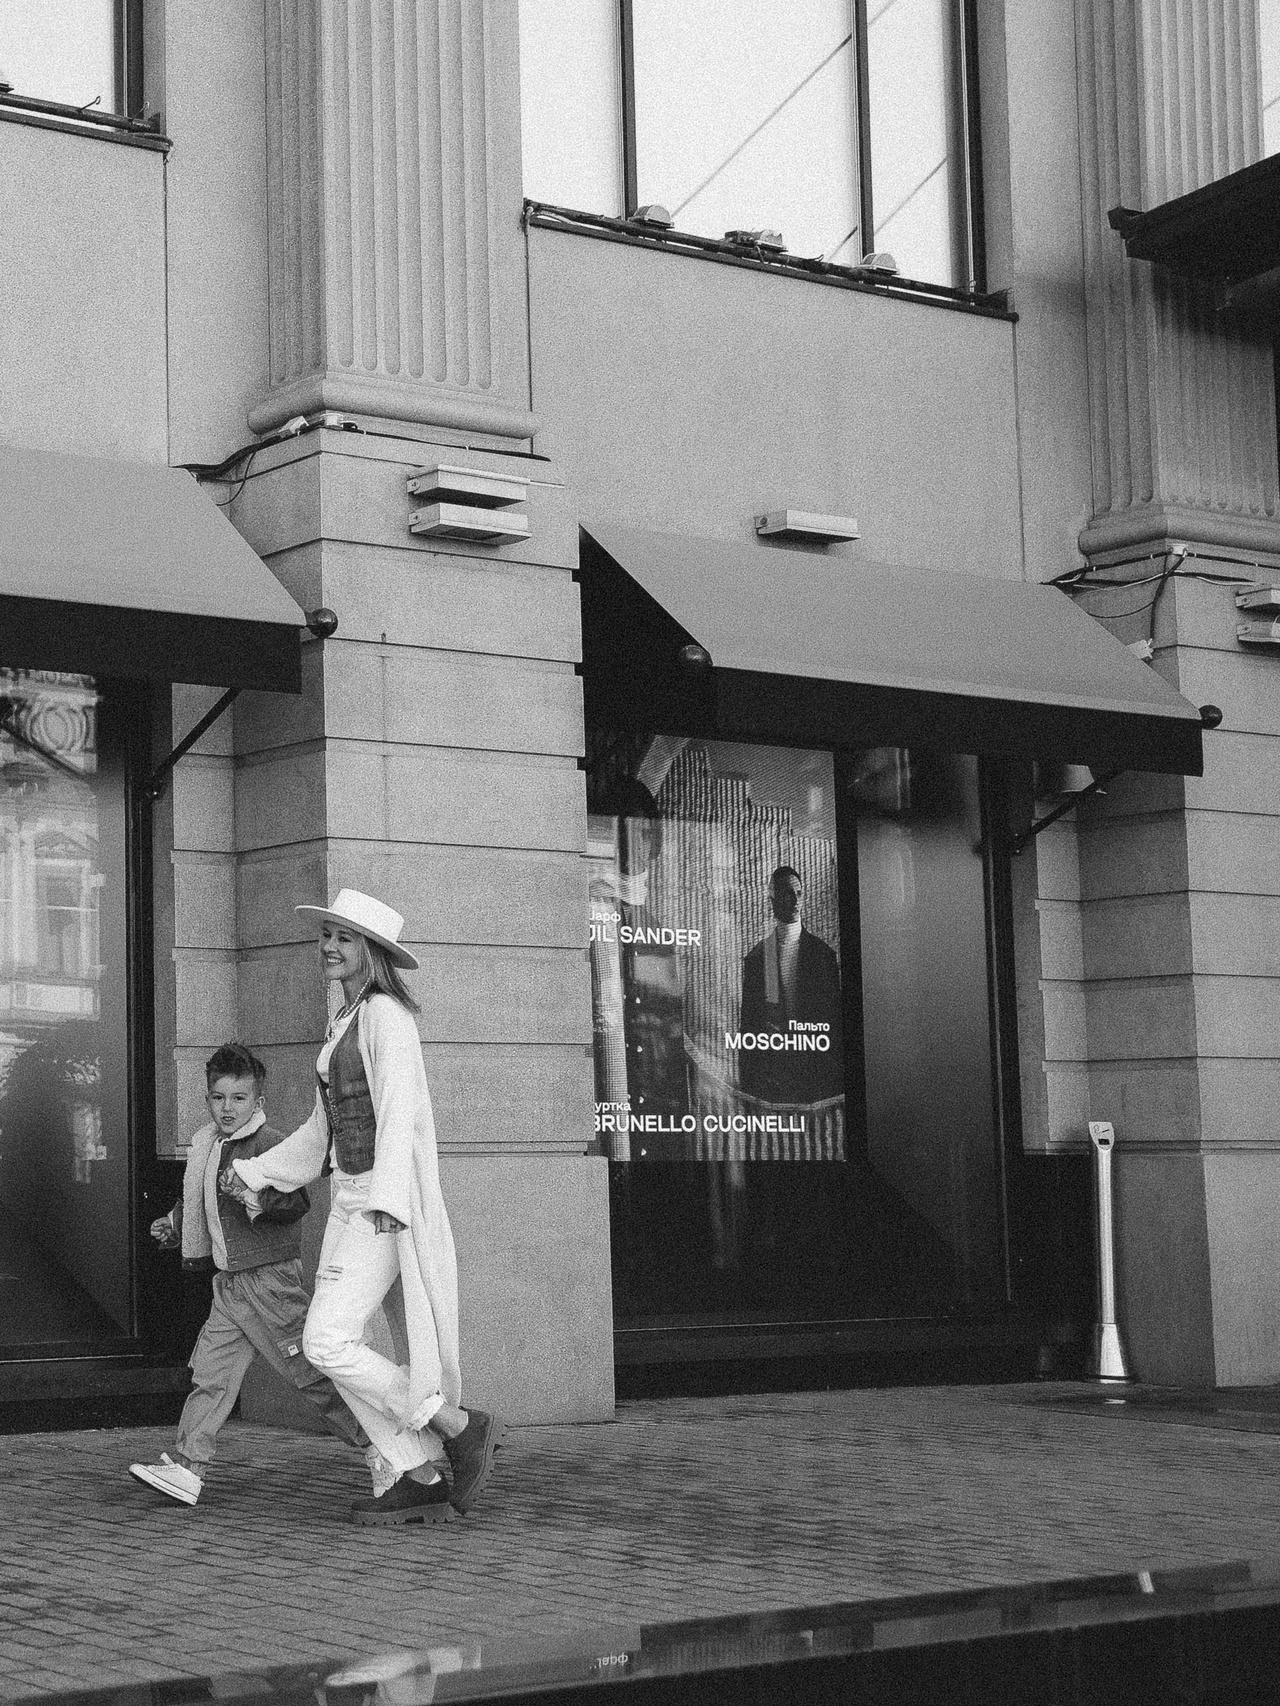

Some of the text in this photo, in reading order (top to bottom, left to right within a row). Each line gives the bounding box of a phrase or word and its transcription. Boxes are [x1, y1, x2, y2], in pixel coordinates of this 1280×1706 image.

[620, 926, 701, 946] SANDER
[788, 1020, 830, 1032] Пальто
[724, 1032, 830, 1052] MOSCHINO
[594, 1102, 632, 1113] уртка
[703, 1114, 805, 1133] CUCINELLI
